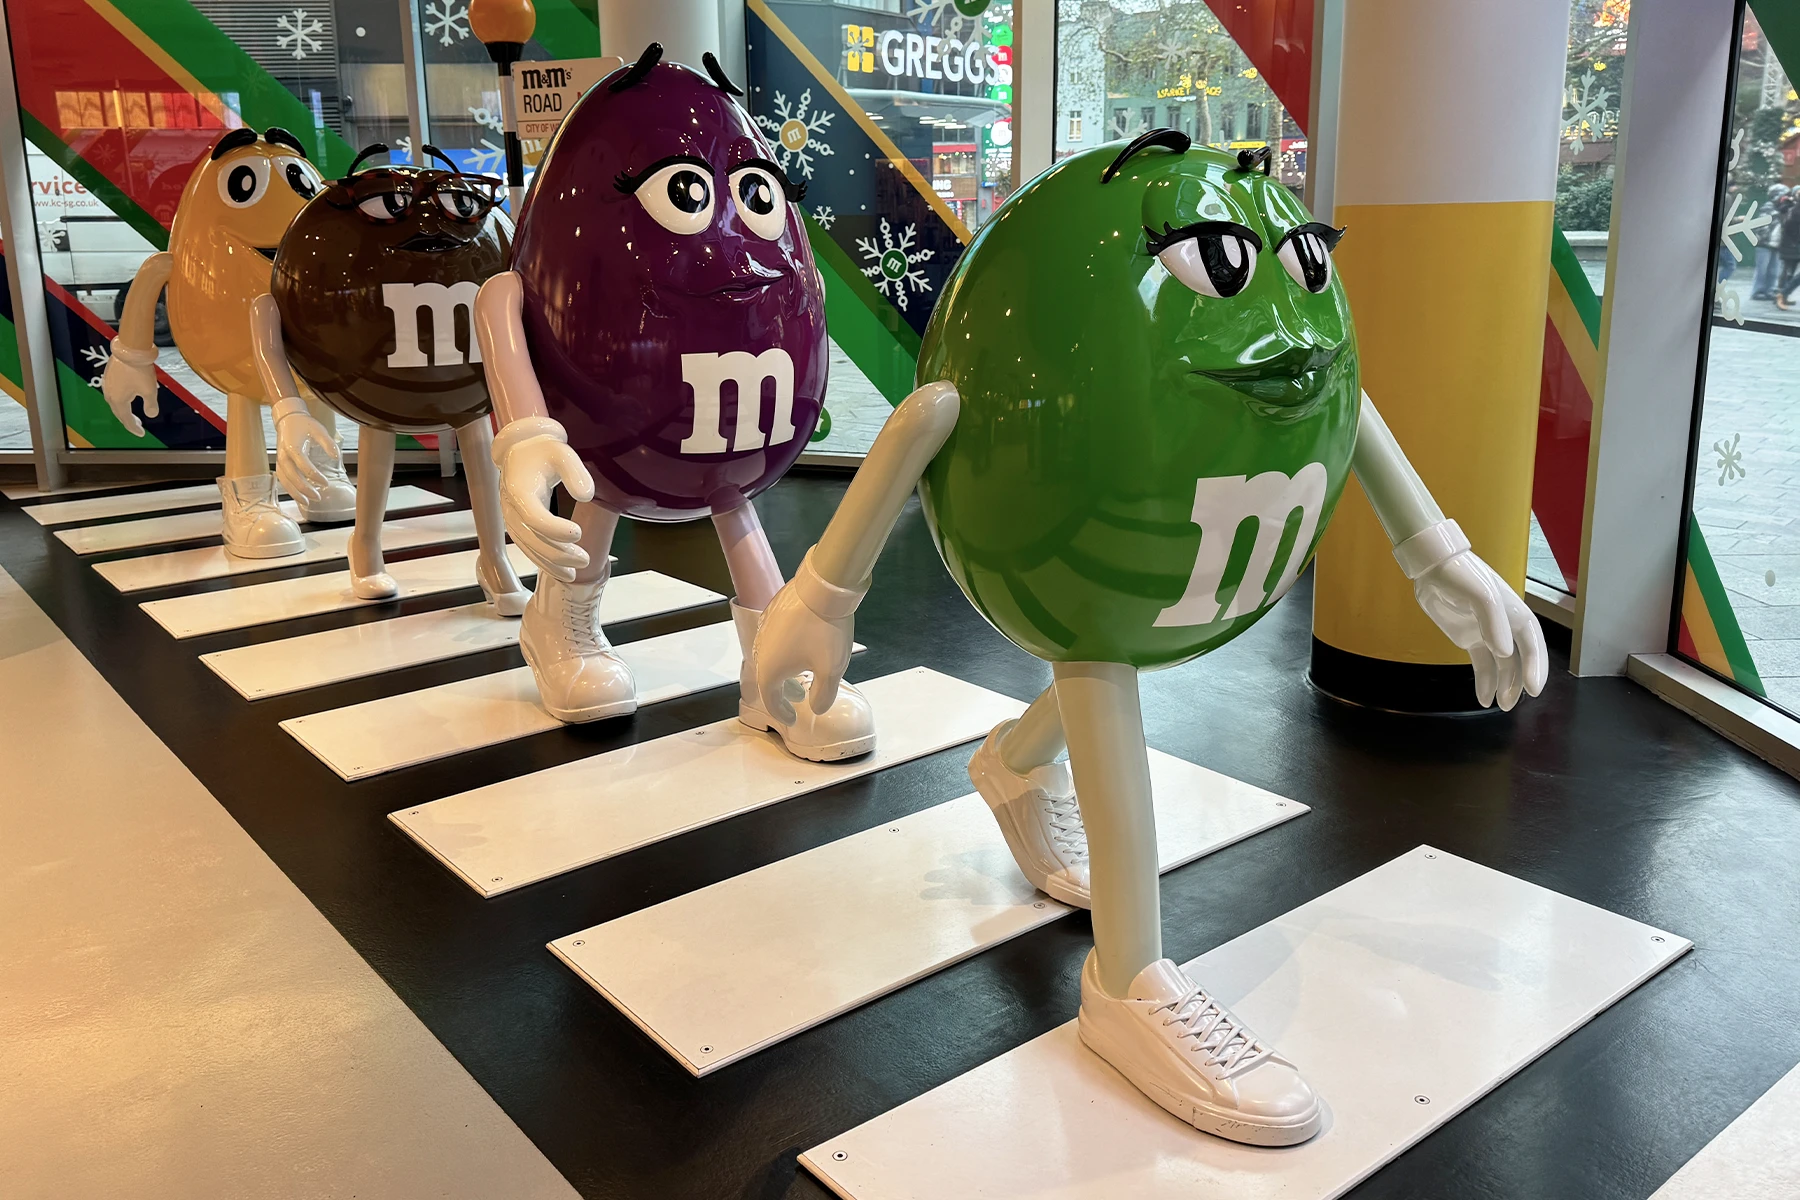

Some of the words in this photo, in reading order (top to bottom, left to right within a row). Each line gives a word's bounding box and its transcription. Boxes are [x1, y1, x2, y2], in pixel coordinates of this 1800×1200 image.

[881, 29, 1000, 85] GREGGS
[523, 93, 562, 113] ROAD
[526, 124, 540, 133] CITY
[540, 123, 549, 133] OF
[381, 281, 483, 368] m
[680, 347, 796, 454] m
[1152, 461, 1328, 628] m
